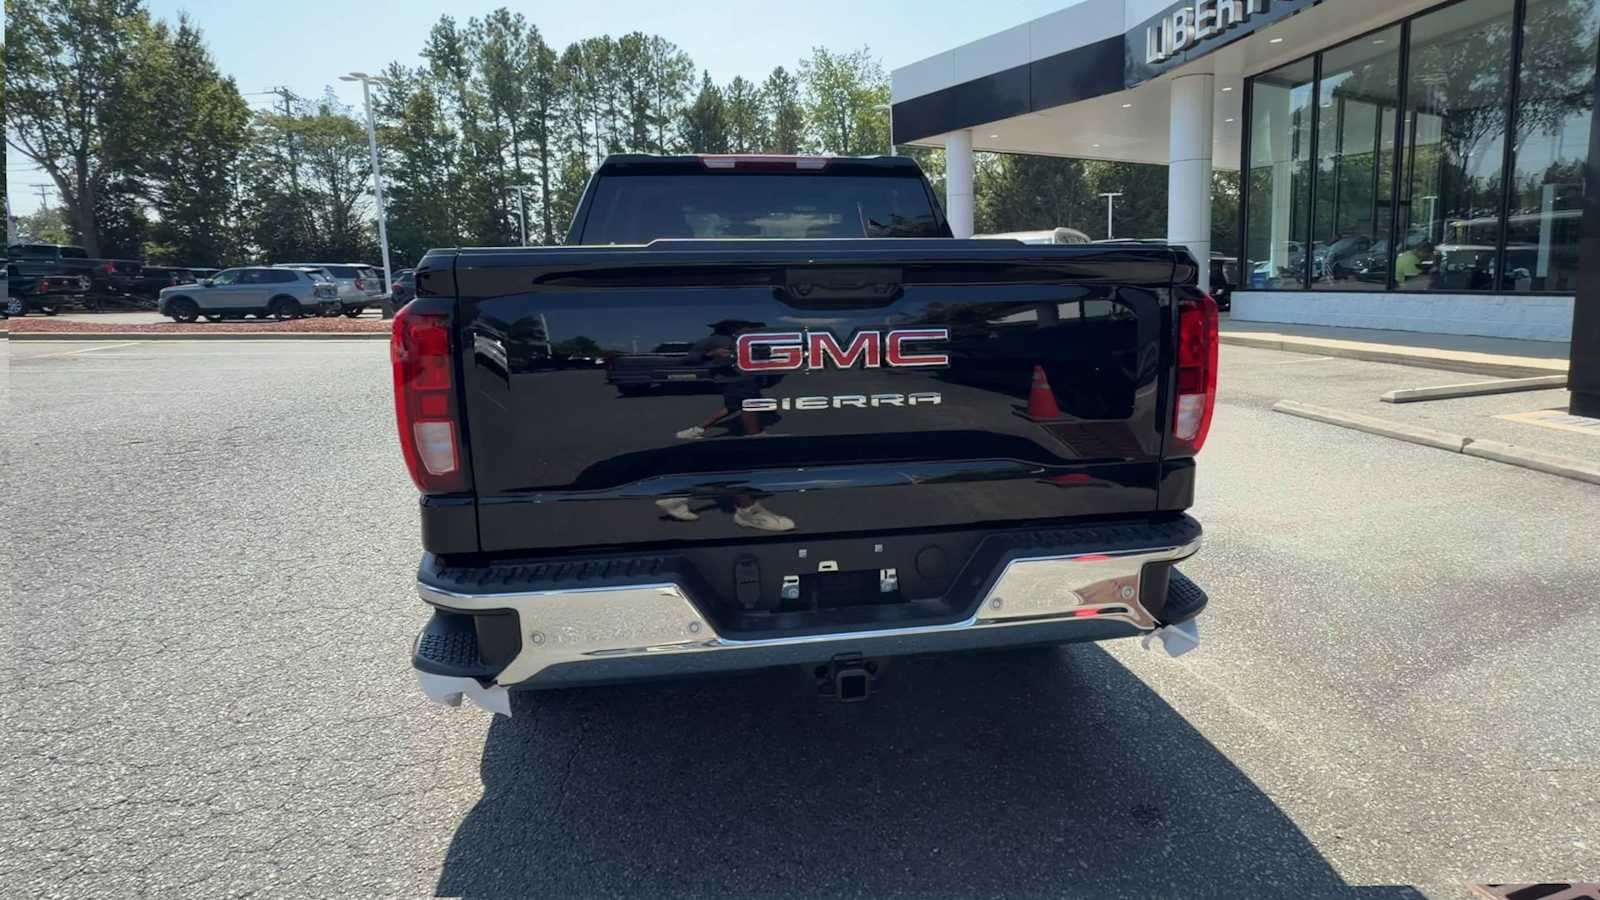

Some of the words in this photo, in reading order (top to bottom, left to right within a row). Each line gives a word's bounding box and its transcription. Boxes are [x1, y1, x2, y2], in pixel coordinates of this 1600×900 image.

[1146, 0, 1262, 64] LIBER
[736, 329, 949, 371] GMC
[741, 392, 942, 412] SIERRA
